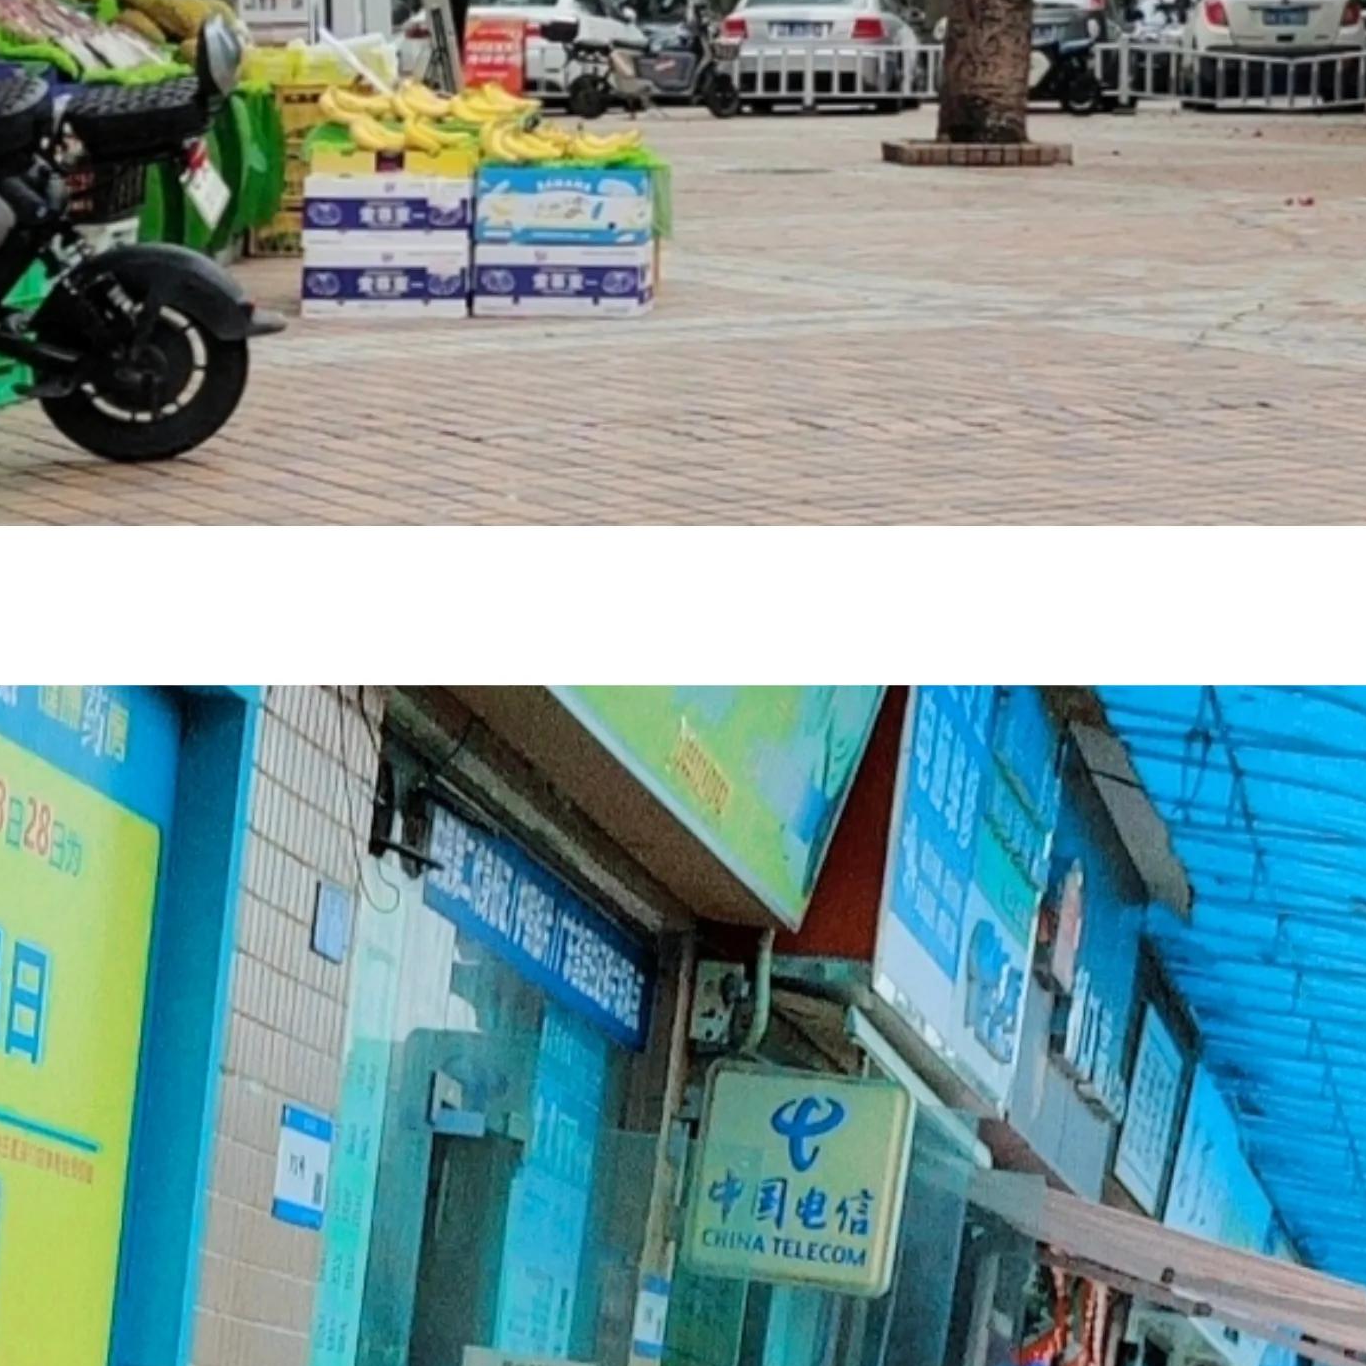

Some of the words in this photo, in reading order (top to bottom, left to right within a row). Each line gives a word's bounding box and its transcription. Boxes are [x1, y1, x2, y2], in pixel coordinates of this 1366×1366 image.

[706, 1173, 873, 1237] 中国电信
[702, 1228, 766, 1261] CHINA
[772, 1236, 867, 1268] TELECOM
